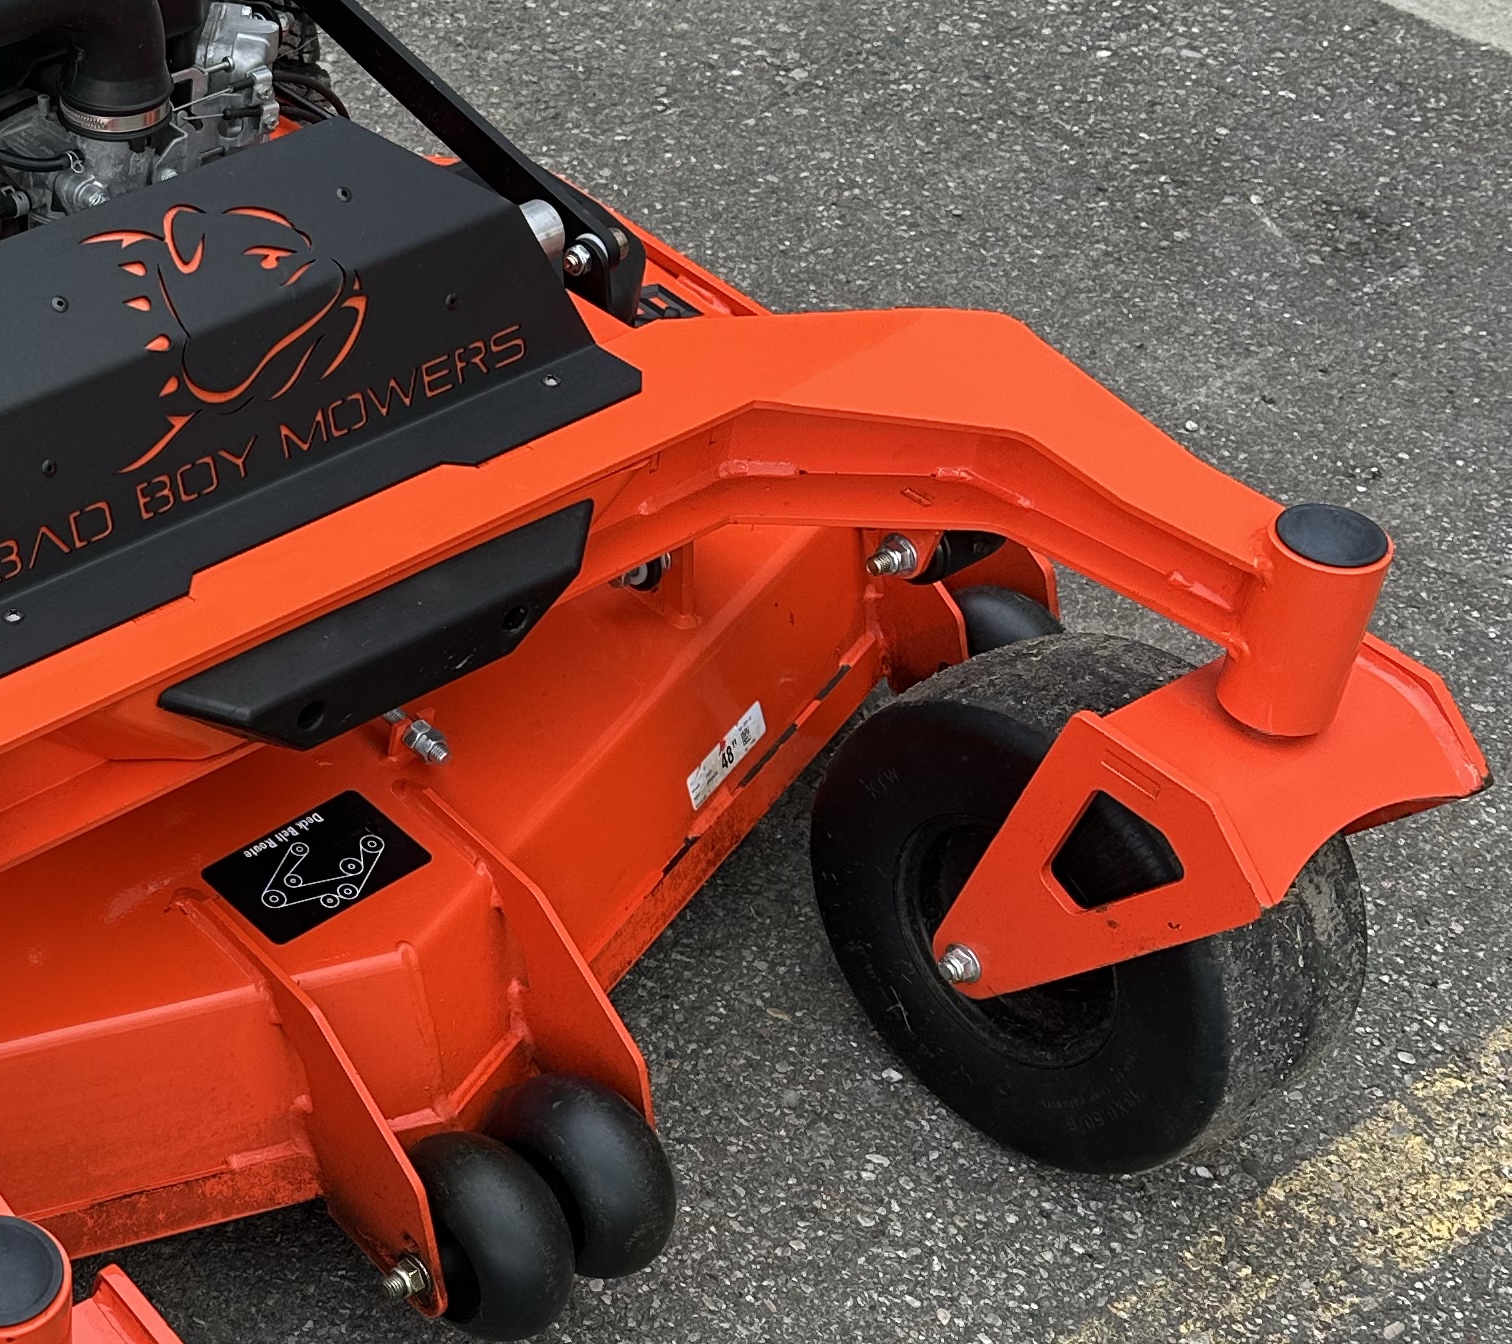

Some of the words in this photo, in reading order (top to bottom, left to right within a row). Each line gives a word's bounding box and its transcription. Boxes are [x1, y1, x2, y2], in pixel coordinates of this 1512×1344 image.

[135, 435, 259, 521] BOY
[278, 323, 528, 459] MOWERS
[295, 812, 324, 831] Deck
[274, 826, 300, 842] Belt
[243, 838, 278, 858] Route
